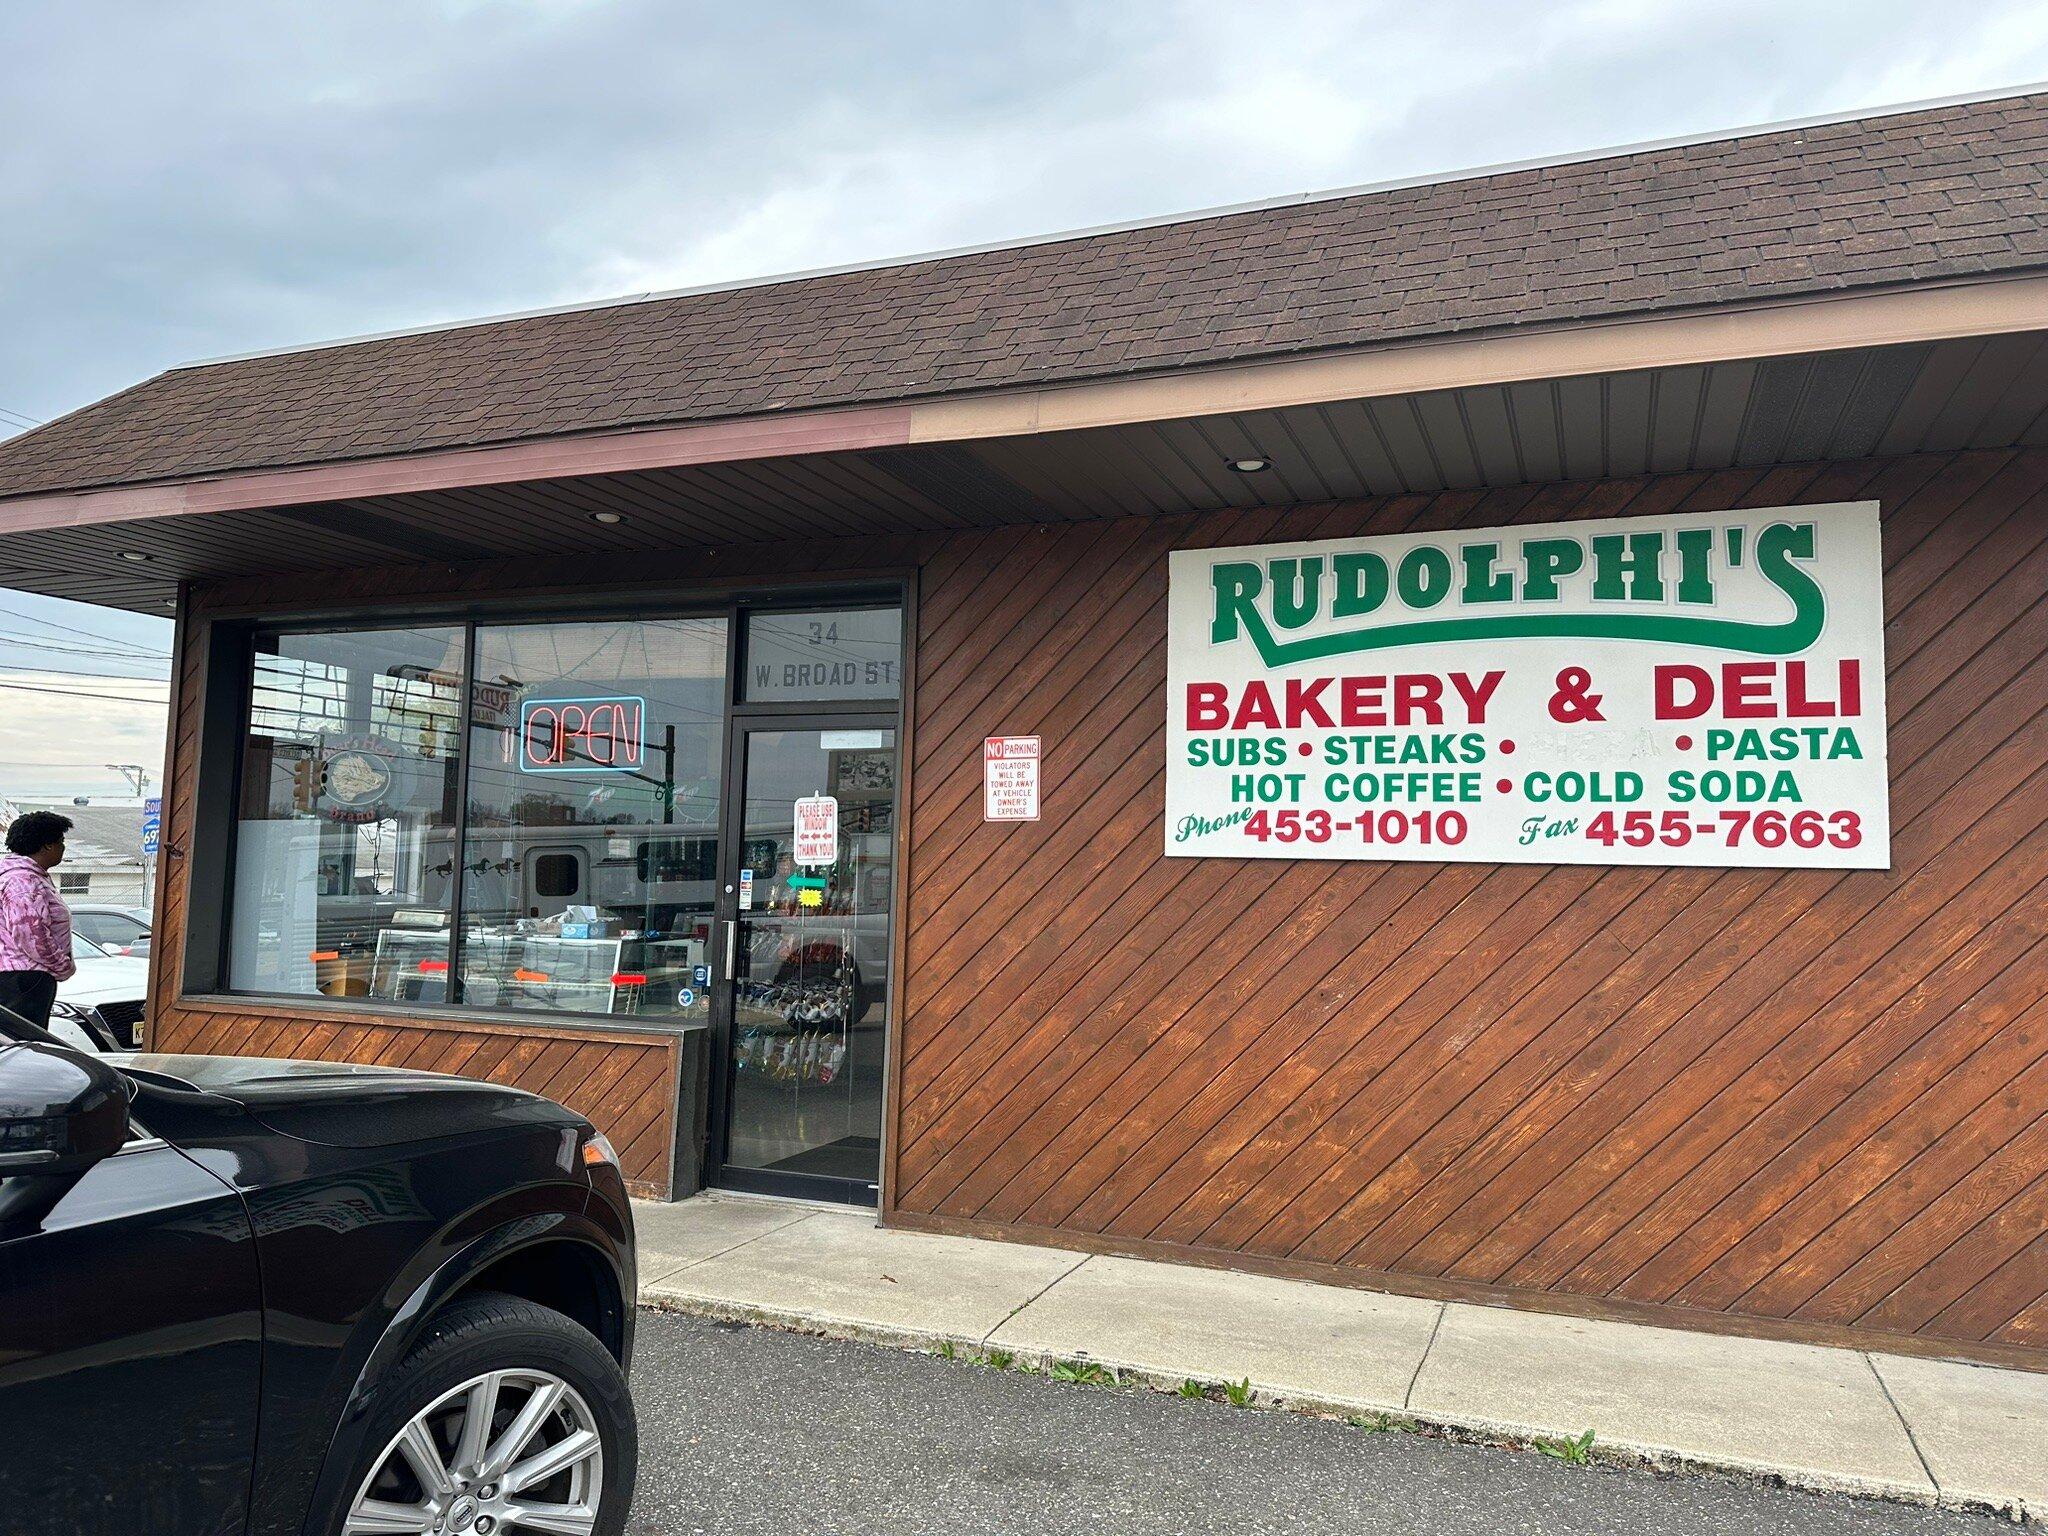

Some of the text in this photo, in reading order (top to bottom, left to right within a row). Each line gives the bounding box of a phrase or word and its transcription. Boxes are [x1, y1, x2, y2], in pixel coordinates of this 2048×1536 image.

[1210, 521, 1826, 670] RUDOLPHI'S
[808, 622, 839, 645] 34
[783, 662, 857, 687] BROAD
[1186, 659, 1862, 731] BAKERY & DELI
[526, 703, 640, 765] OPEN
[987, 742, 1037, 758] NO PARKING
[1187, 738, 1288, 767] SUBS
[1324, 733, 1487, 765] STEAKS
[1707, 727, 1863, 761] PASTA
[993, 762, 1031, 770] VIOLATORS
[998, 771, 1026, 779] WILL BE
[990, 780, 1034, 788] TOWED AWAY
[1232, 770, 1803, 803] HOT COFFEE COLD SODA
[1003, 789, 1032, 797] VEHICLE
[145, 801, 162, 813] SOU
[997, 798, 1027, 806] OWNER'S
[798, 804, 833, 818] PLEASE USE
[804, 818, 828, 830] WINDOW
[1175, 807, 1862, 849] Phone 453-1010 Fax 455-7663
[798, 843, 818, 857] THANK
